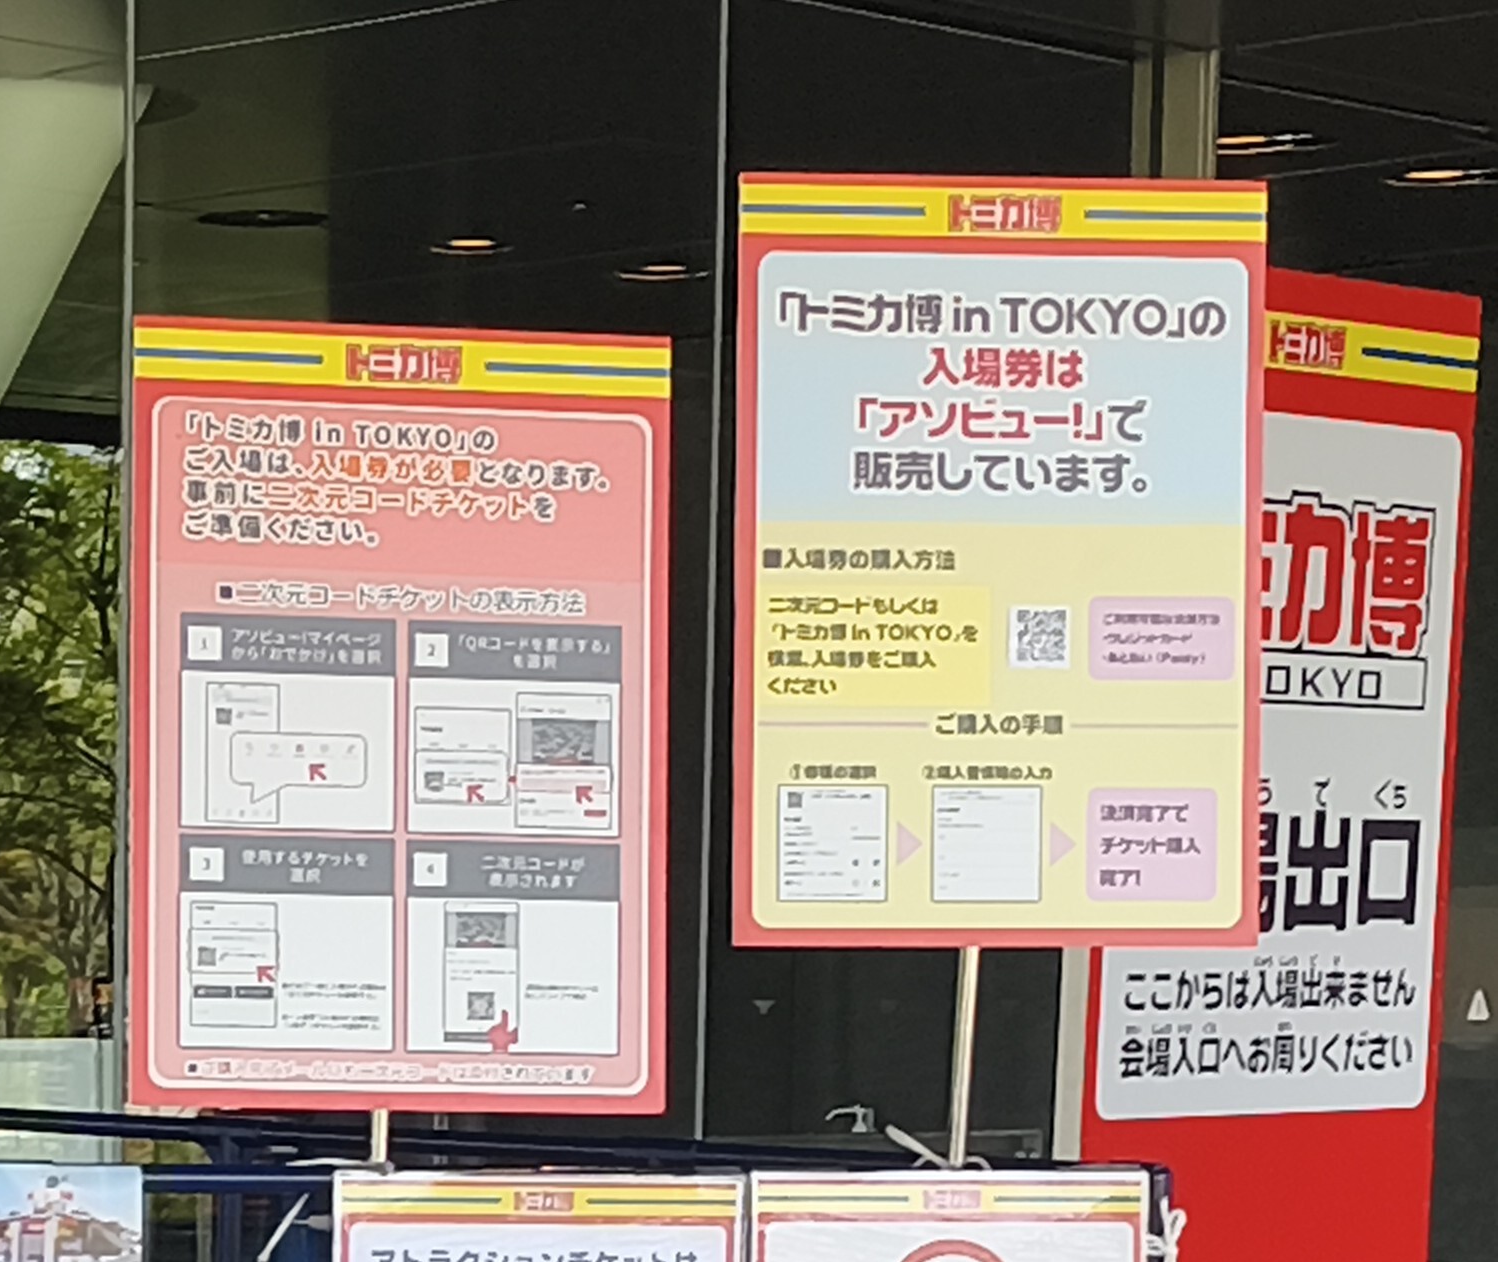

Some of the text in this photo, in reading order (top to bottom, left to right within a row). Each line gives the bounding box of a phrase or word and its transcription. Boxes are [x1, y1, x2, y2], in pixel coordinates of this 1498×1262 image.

[948, 195, 1062, 231] トミカ博
[779, 292, 1226, 338] 「トミカ博 in TOKYO」の
[346, 345, 462, 383] トミカ博
[1269, 321, 1347, 369] トミカ博
[922, 347, 1084, 388] 入場券は
[185, 414, 495, 452] 「トミカ博 in TOKYO」の
[853, 451, 1148, 492] 販売しています。
[185, 482, 555, 519] 事前に二次元コードチケットを
[183, 514, 379, 546] ご準備ください。
[1261, 504, 1429, 651] カ博
[768, 597, 938, 615] 二次元コードもしくは
[851, 623, 871, 641] in
[767, 677, 837, 694] ください
[1124, 969, 1416, 1010] ここからは入場出来ません
